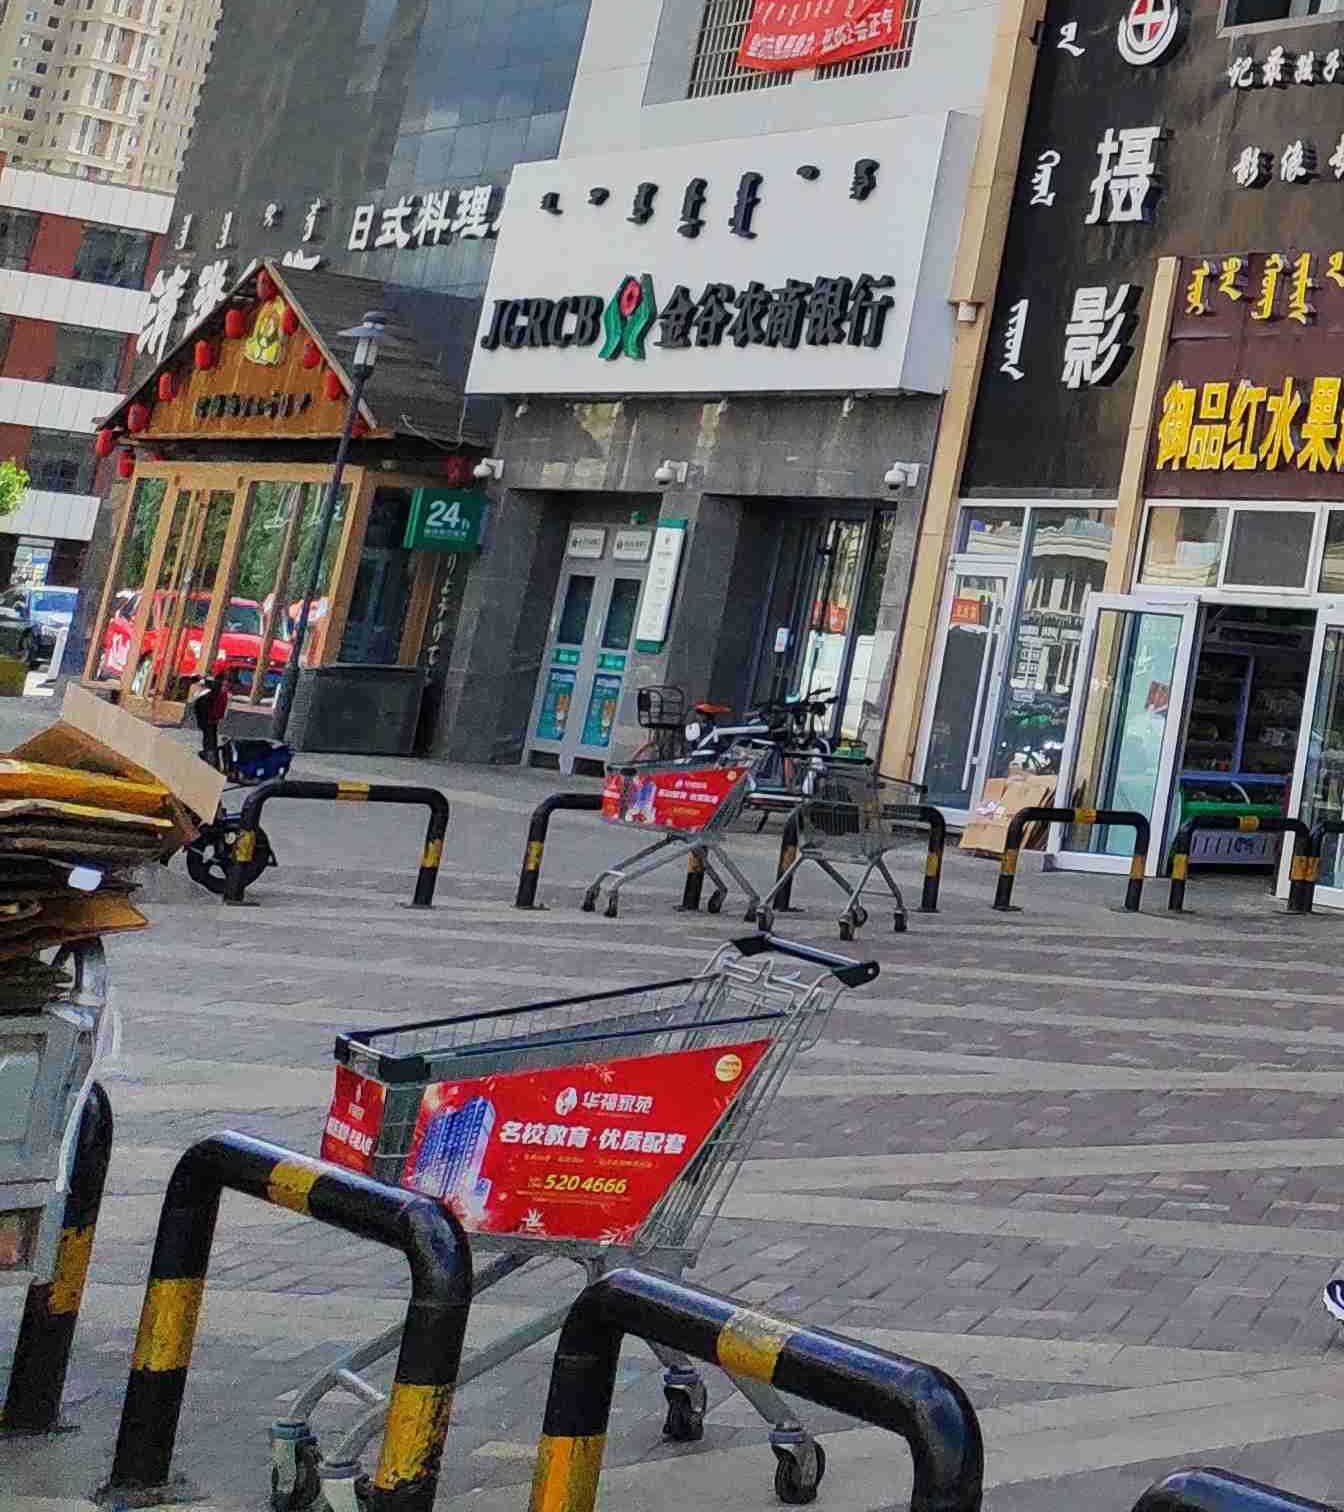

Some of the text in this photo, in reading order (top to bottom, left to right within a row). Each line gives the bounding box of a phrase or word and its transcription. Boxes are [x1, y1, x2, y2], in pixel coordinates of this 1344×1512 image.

[348, 184, 504, 252] 日式料理
[481, 273, 896, 351] JGRCB 金谷农商银行
